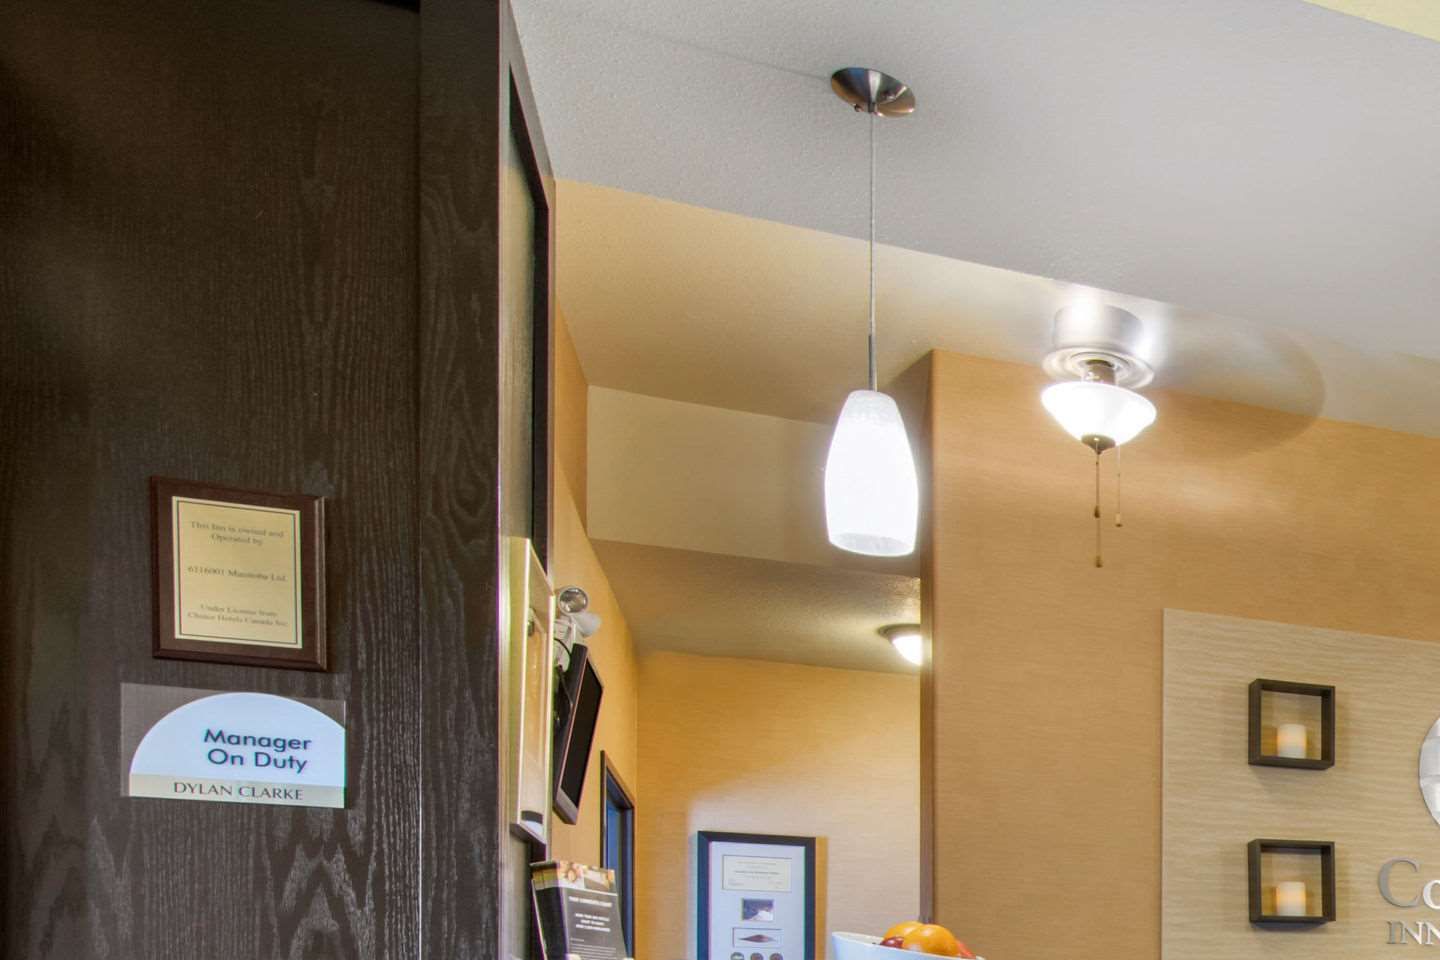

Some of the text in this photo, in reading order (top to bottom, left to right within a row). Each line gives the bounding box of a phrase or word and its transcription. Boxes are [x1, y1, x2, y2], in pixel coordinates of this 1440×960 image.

[204, 728, 312, 753] Manager
[208, 748, 308, 774] On Duty
[174, 781, 303, 800] DYLAN CLARKE
